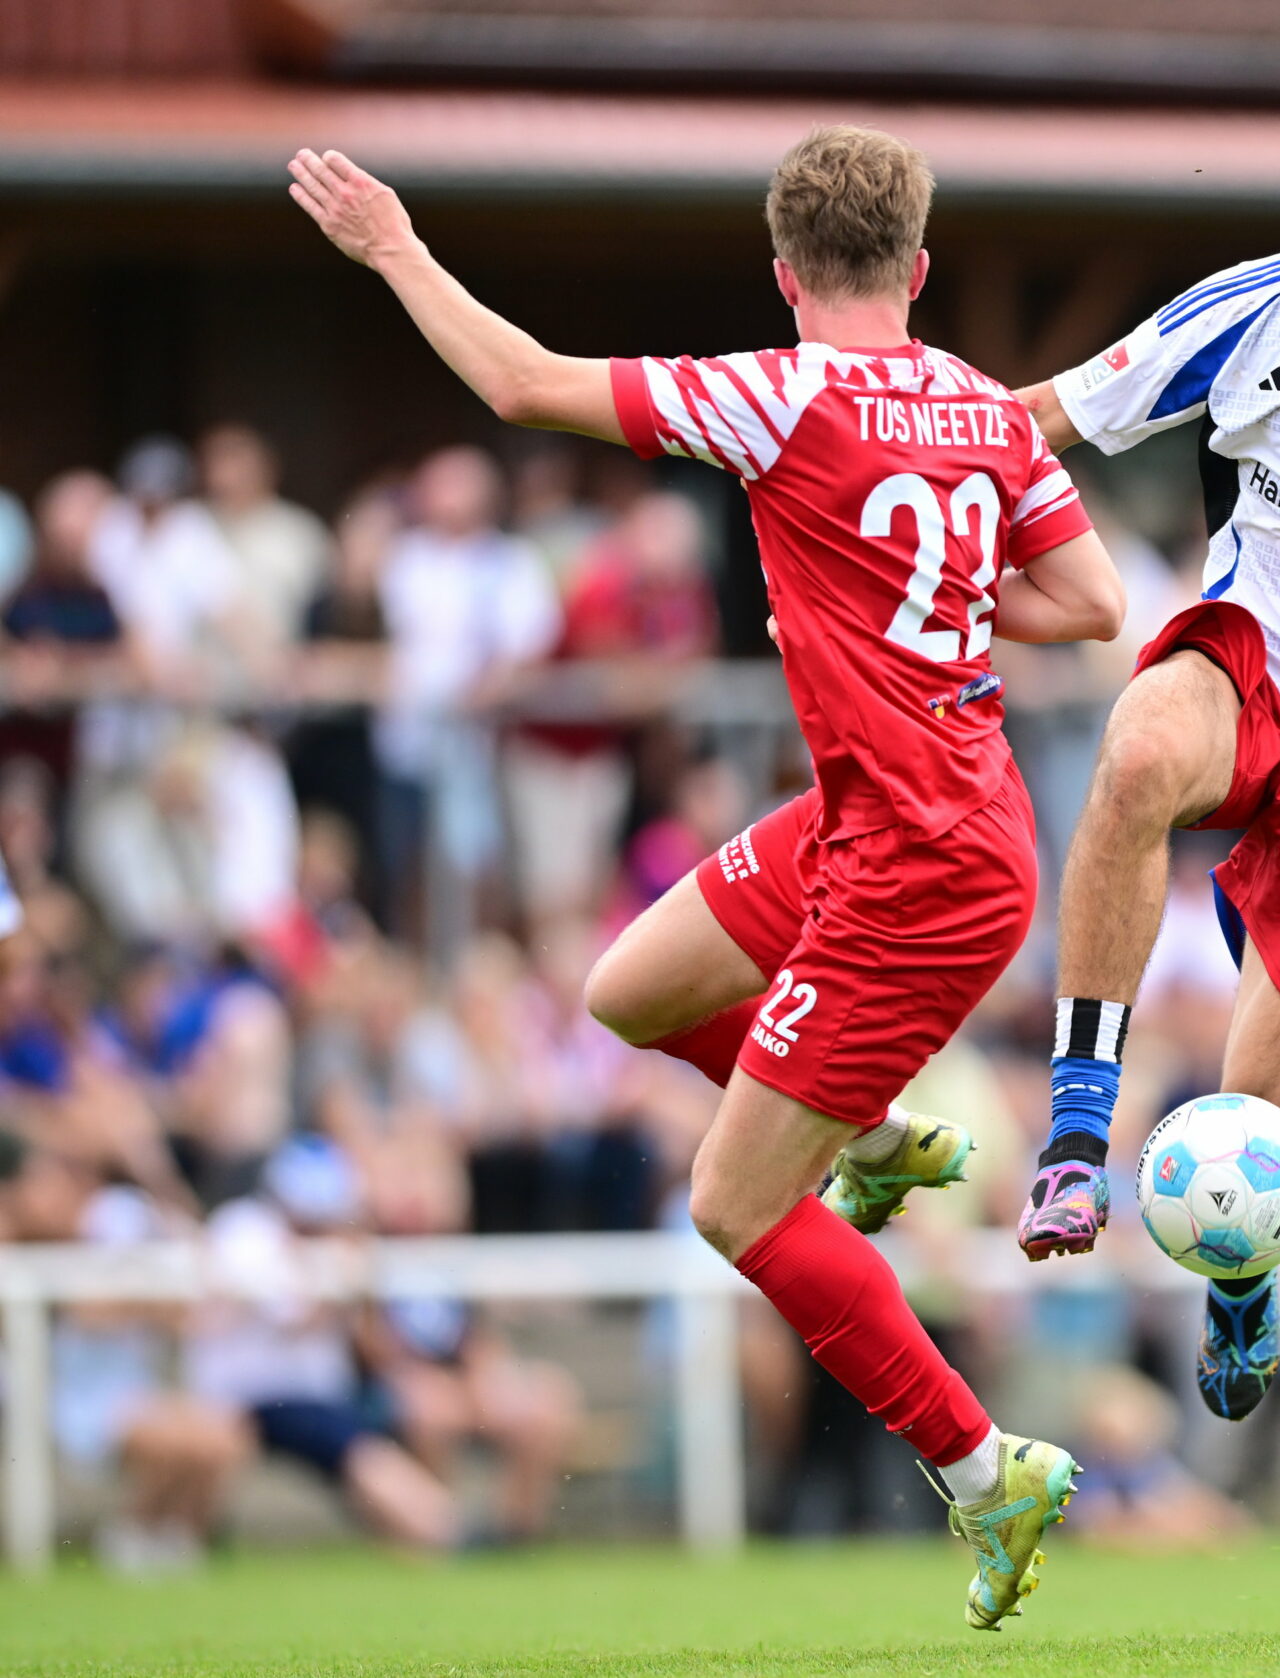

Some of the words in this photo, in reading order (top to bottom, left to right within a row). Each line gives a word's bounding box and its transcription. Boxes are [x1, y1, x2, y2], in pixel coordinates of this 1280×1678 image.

[853, 396, 911, 443] TUS
[911, 402, 1009, 447] NEETZE
[859, 472, 1001, 663] 22
[729, 834, 749, 880] OLAR
[758, 968, 818, 1043] 22
[751, 1023, 790, 1058] JAKO
[1221, 1189, 1239, 1217] SELECT
